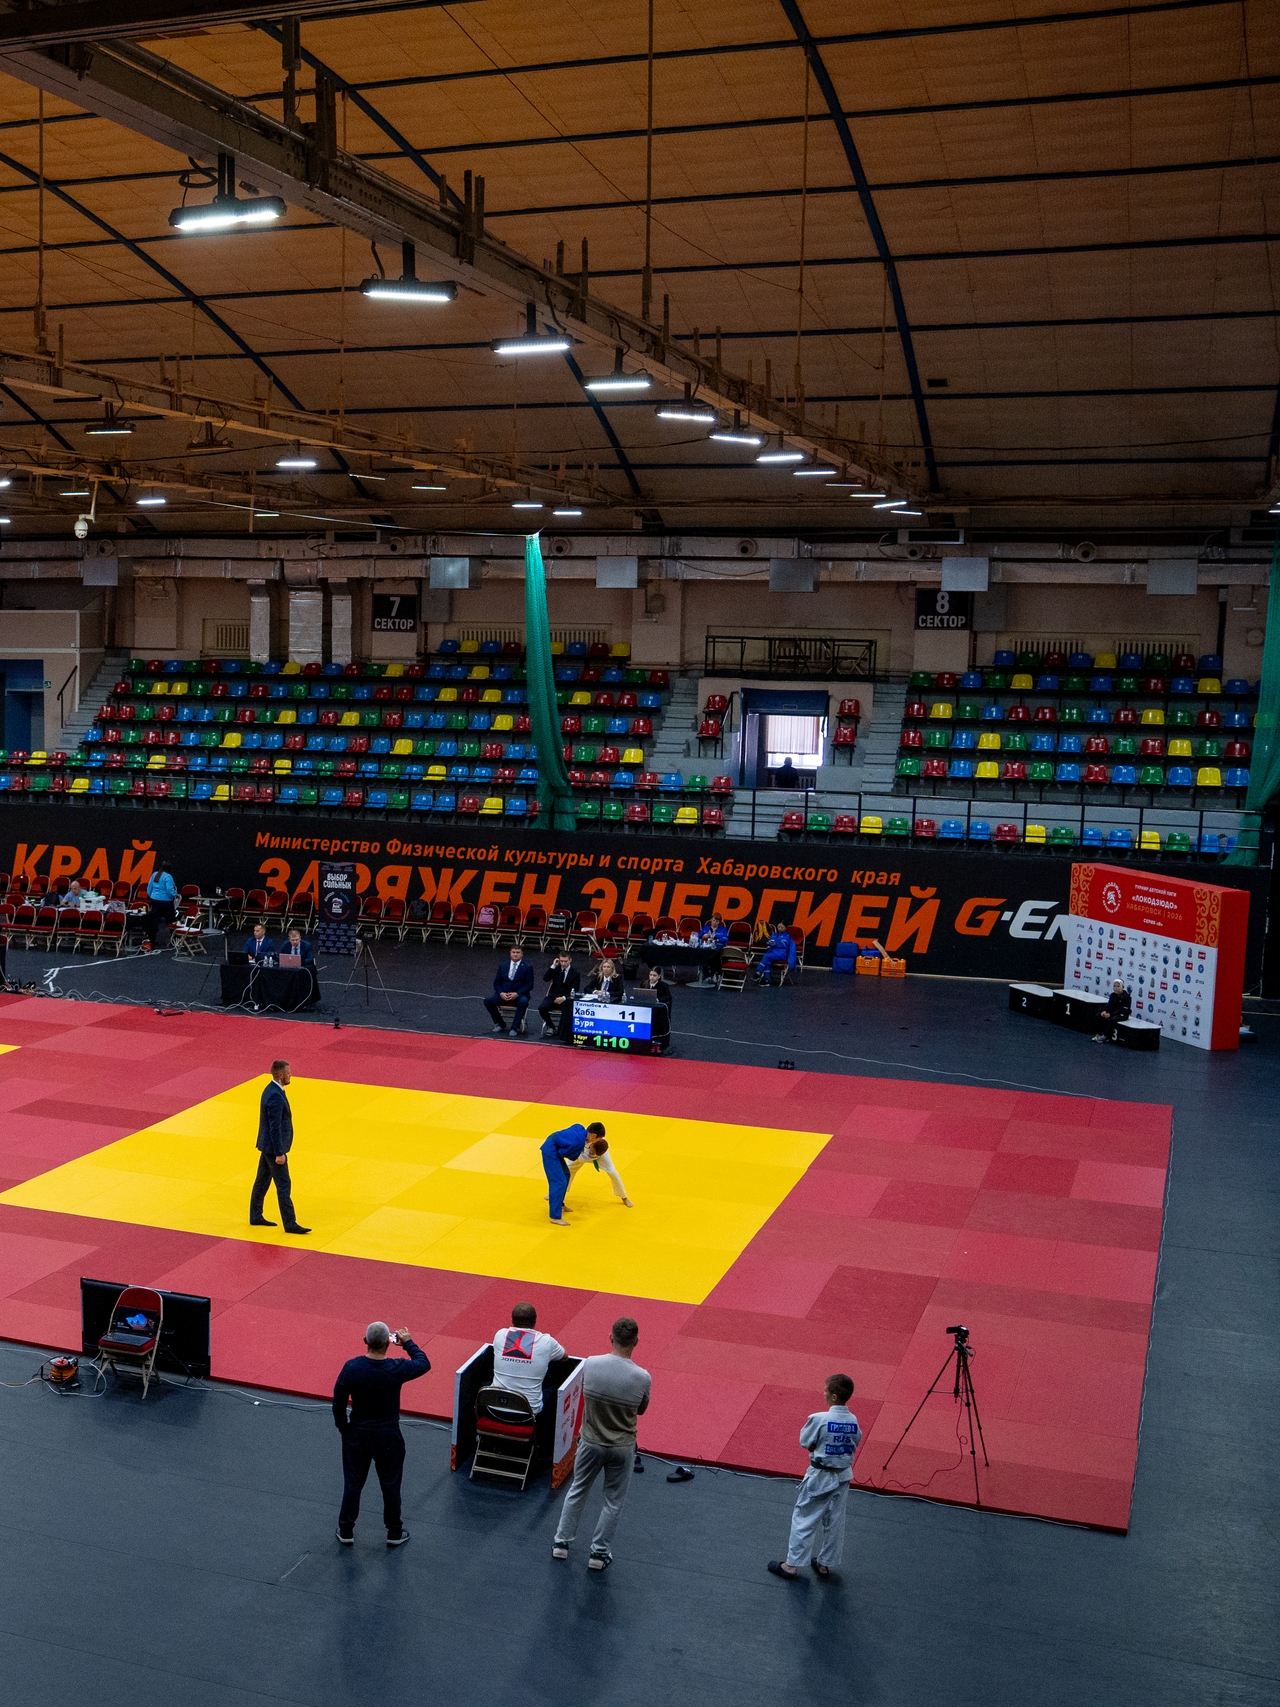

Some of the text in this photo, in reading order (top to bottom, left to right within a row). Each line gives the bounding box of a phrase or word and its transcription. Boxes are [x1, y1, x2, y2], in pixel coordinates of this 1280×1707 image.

[390, 597, 400, 617] 7
[936, 591, 949, 614] 8
[374, 618, 414, 630] СЕКТОР
[918, 615, 966, 627] СЕКТОР
[256, 832, 901, 889] Министерство Физической культуры и спорта Хабаровского края
[11, 839, 157, 898] КРАЙ
[327, 873, 348, 881] ВЫБОР
[323, 880, 352, 889] СИЛЬНЫХ
[1132, 895, 1178, 910] «ЛОКОДЗЮДО»
[580, 877, 940, 954] ЭНЕРГИЕЙ
[1126, 903, 1162, 916] ХАБАРОВСК
[1167, 912, 1183, 921] 2026
[1022, 997, 1027, 1007] 2
[1065, 1003, 1071, 1015] 1
[574, 1007, 635, 1020] Хаба 11
[574, 1018, 635, 1033] Буря 1
[593, 1035, 630, 1049] 1:10
[1112, 1029, 1118, 1041] 3
